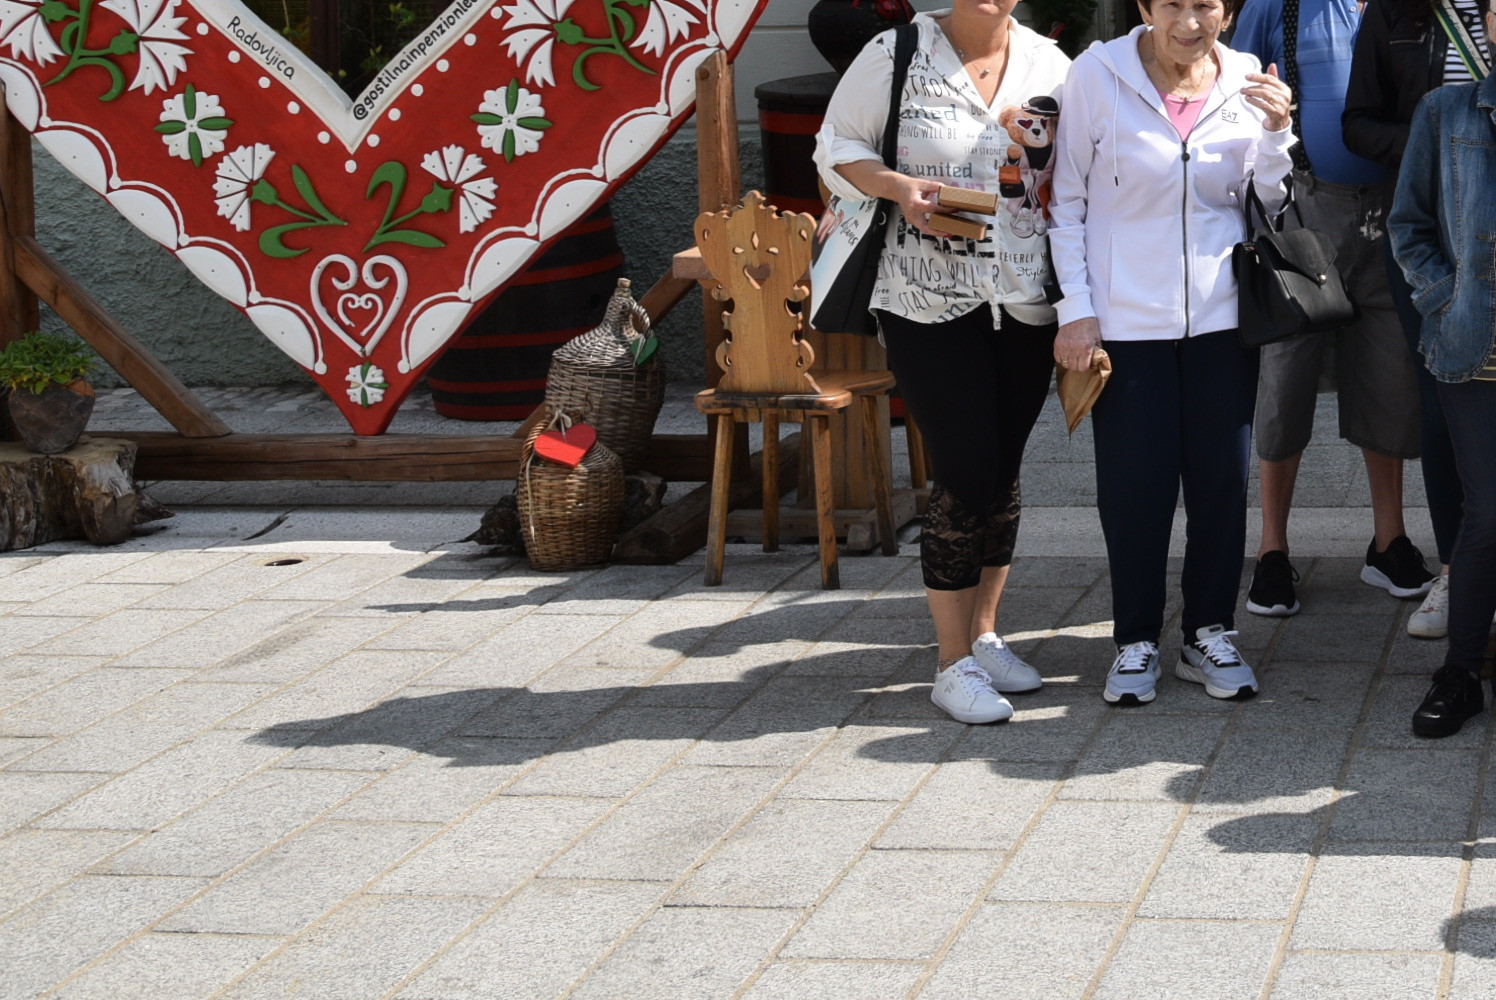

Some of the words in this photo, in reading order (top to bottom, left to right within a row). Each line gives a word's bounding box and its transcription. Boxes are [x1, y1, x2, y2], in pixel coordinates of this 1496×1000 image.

[227, 15, 295, 80] Radovljica
[1221, 109, 1238, 121] EA7
[915, 161, 974, 179] united
